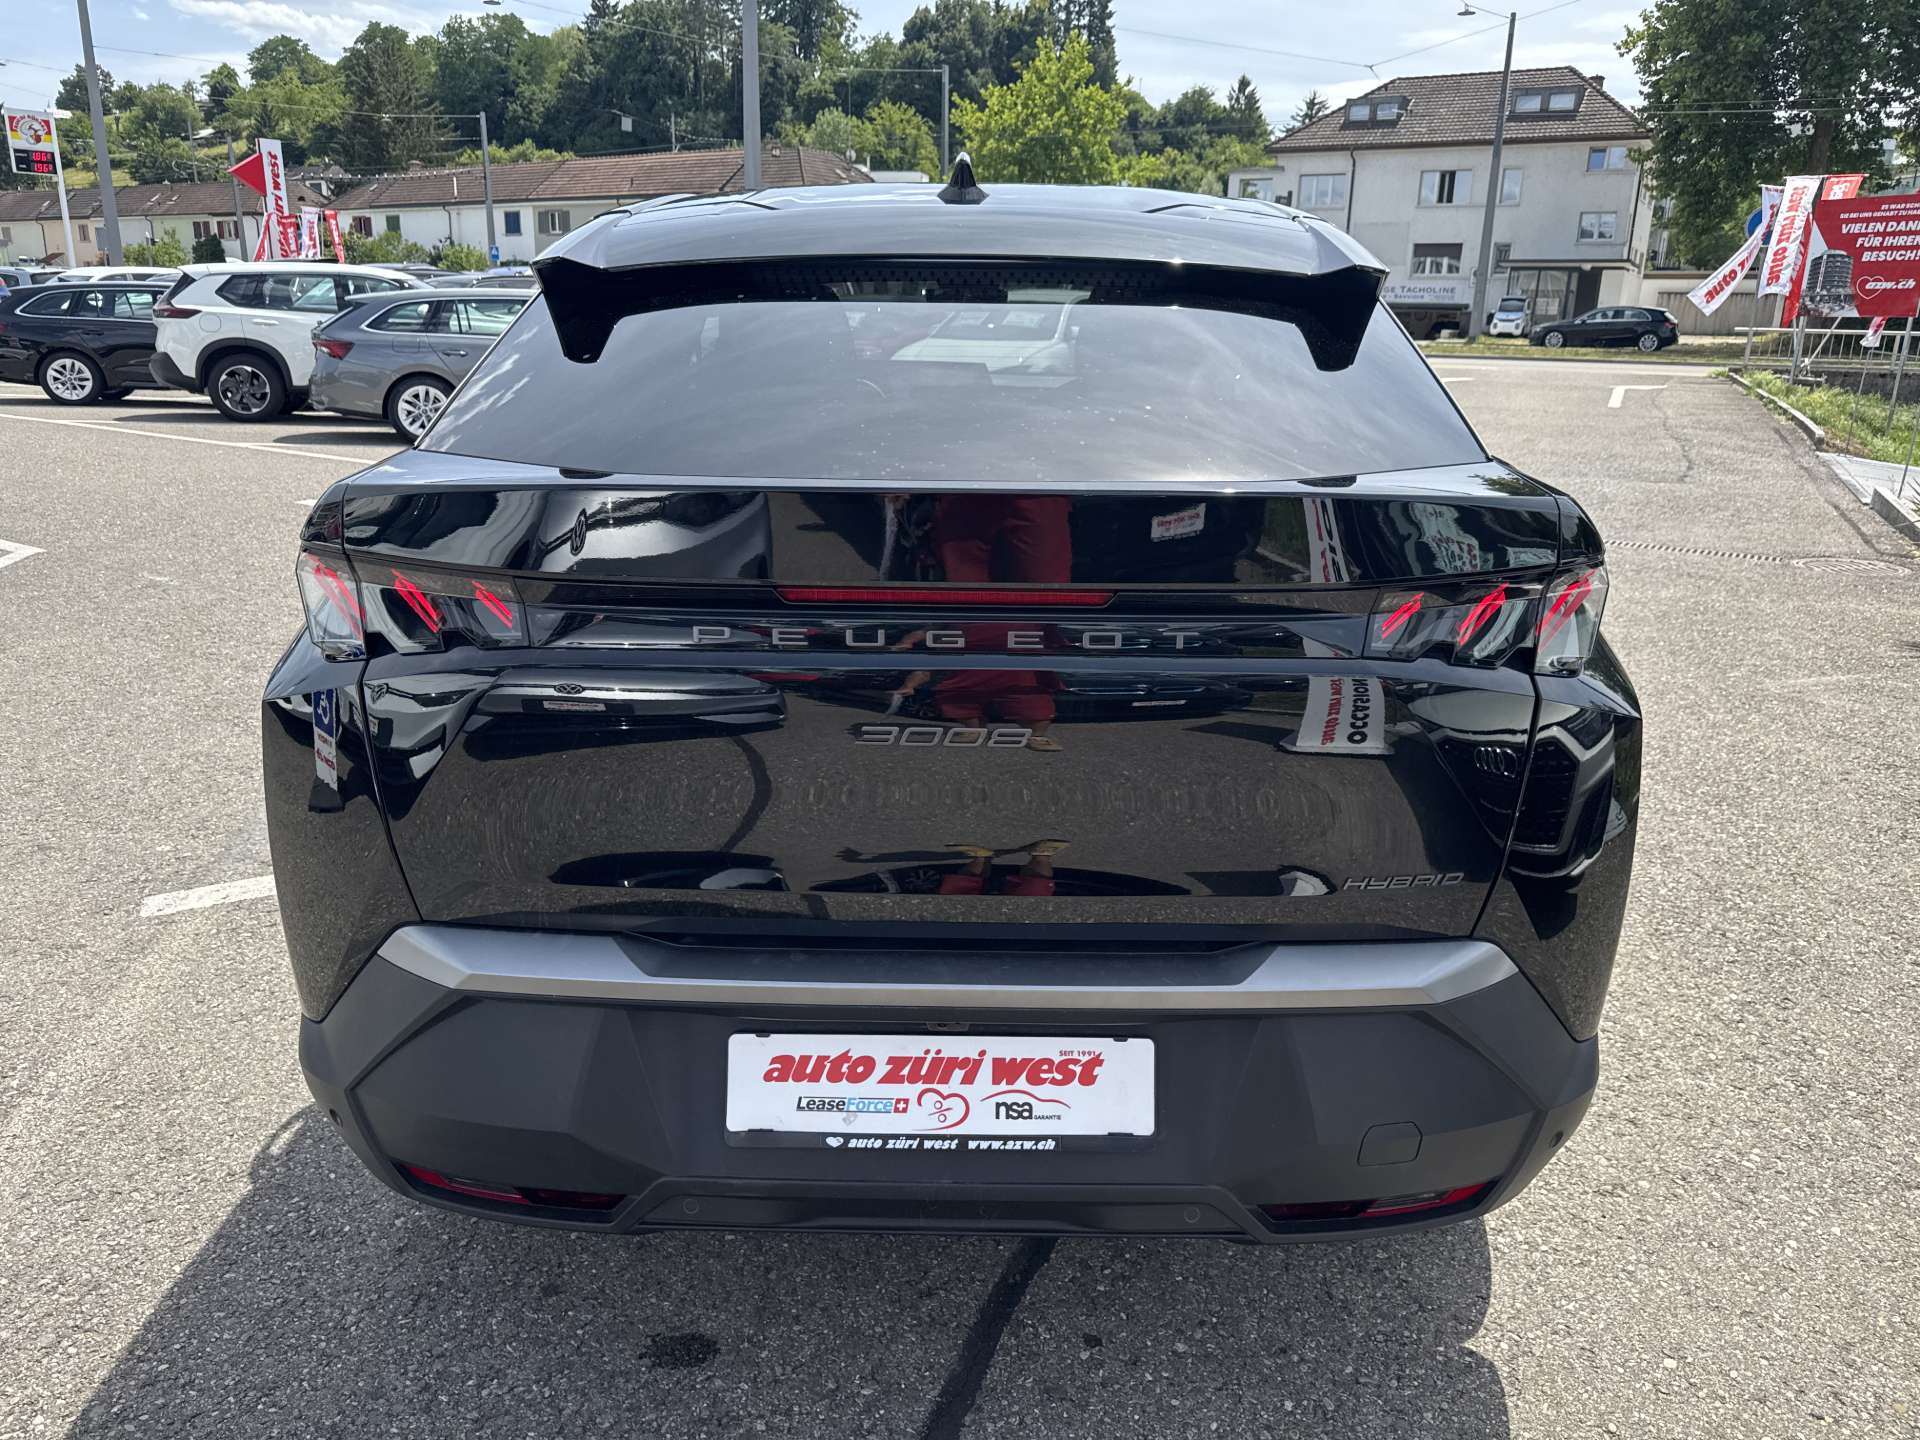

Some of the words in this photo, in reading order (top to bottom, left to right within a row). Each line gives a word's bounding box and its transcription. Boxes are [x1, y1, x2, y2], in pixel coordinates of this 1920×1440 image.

[268, 151, 282, 191] west
[1841, 222, 1886, 234] VIELEN
[1856, 234, 1883, 247] FÜR
[1400, 286, 1457, 294] TACHOLINE
[1704, 268, 1738, 304] auto
[692, 625, 1201, 651] PEUGEOT
[854, 725, 1033, 748] 3008
[1343, 872, 1464, 890] HYBRID
[763, 1048, 877, 1083] auto
[877, 1048, 987, 1085] züri
[992, 1051, 1104, 1087] west
[797, 1096, 893, 1112] LeaseForce
[995, 1101, 1033, 1120] nsa
[848, 1137, 883, 1150] auto
[885, 1136, 920, 1150] züri
[923, 1137, 959, 1150] west
[967, 1138, 1056, 1151] www.azw.ch
